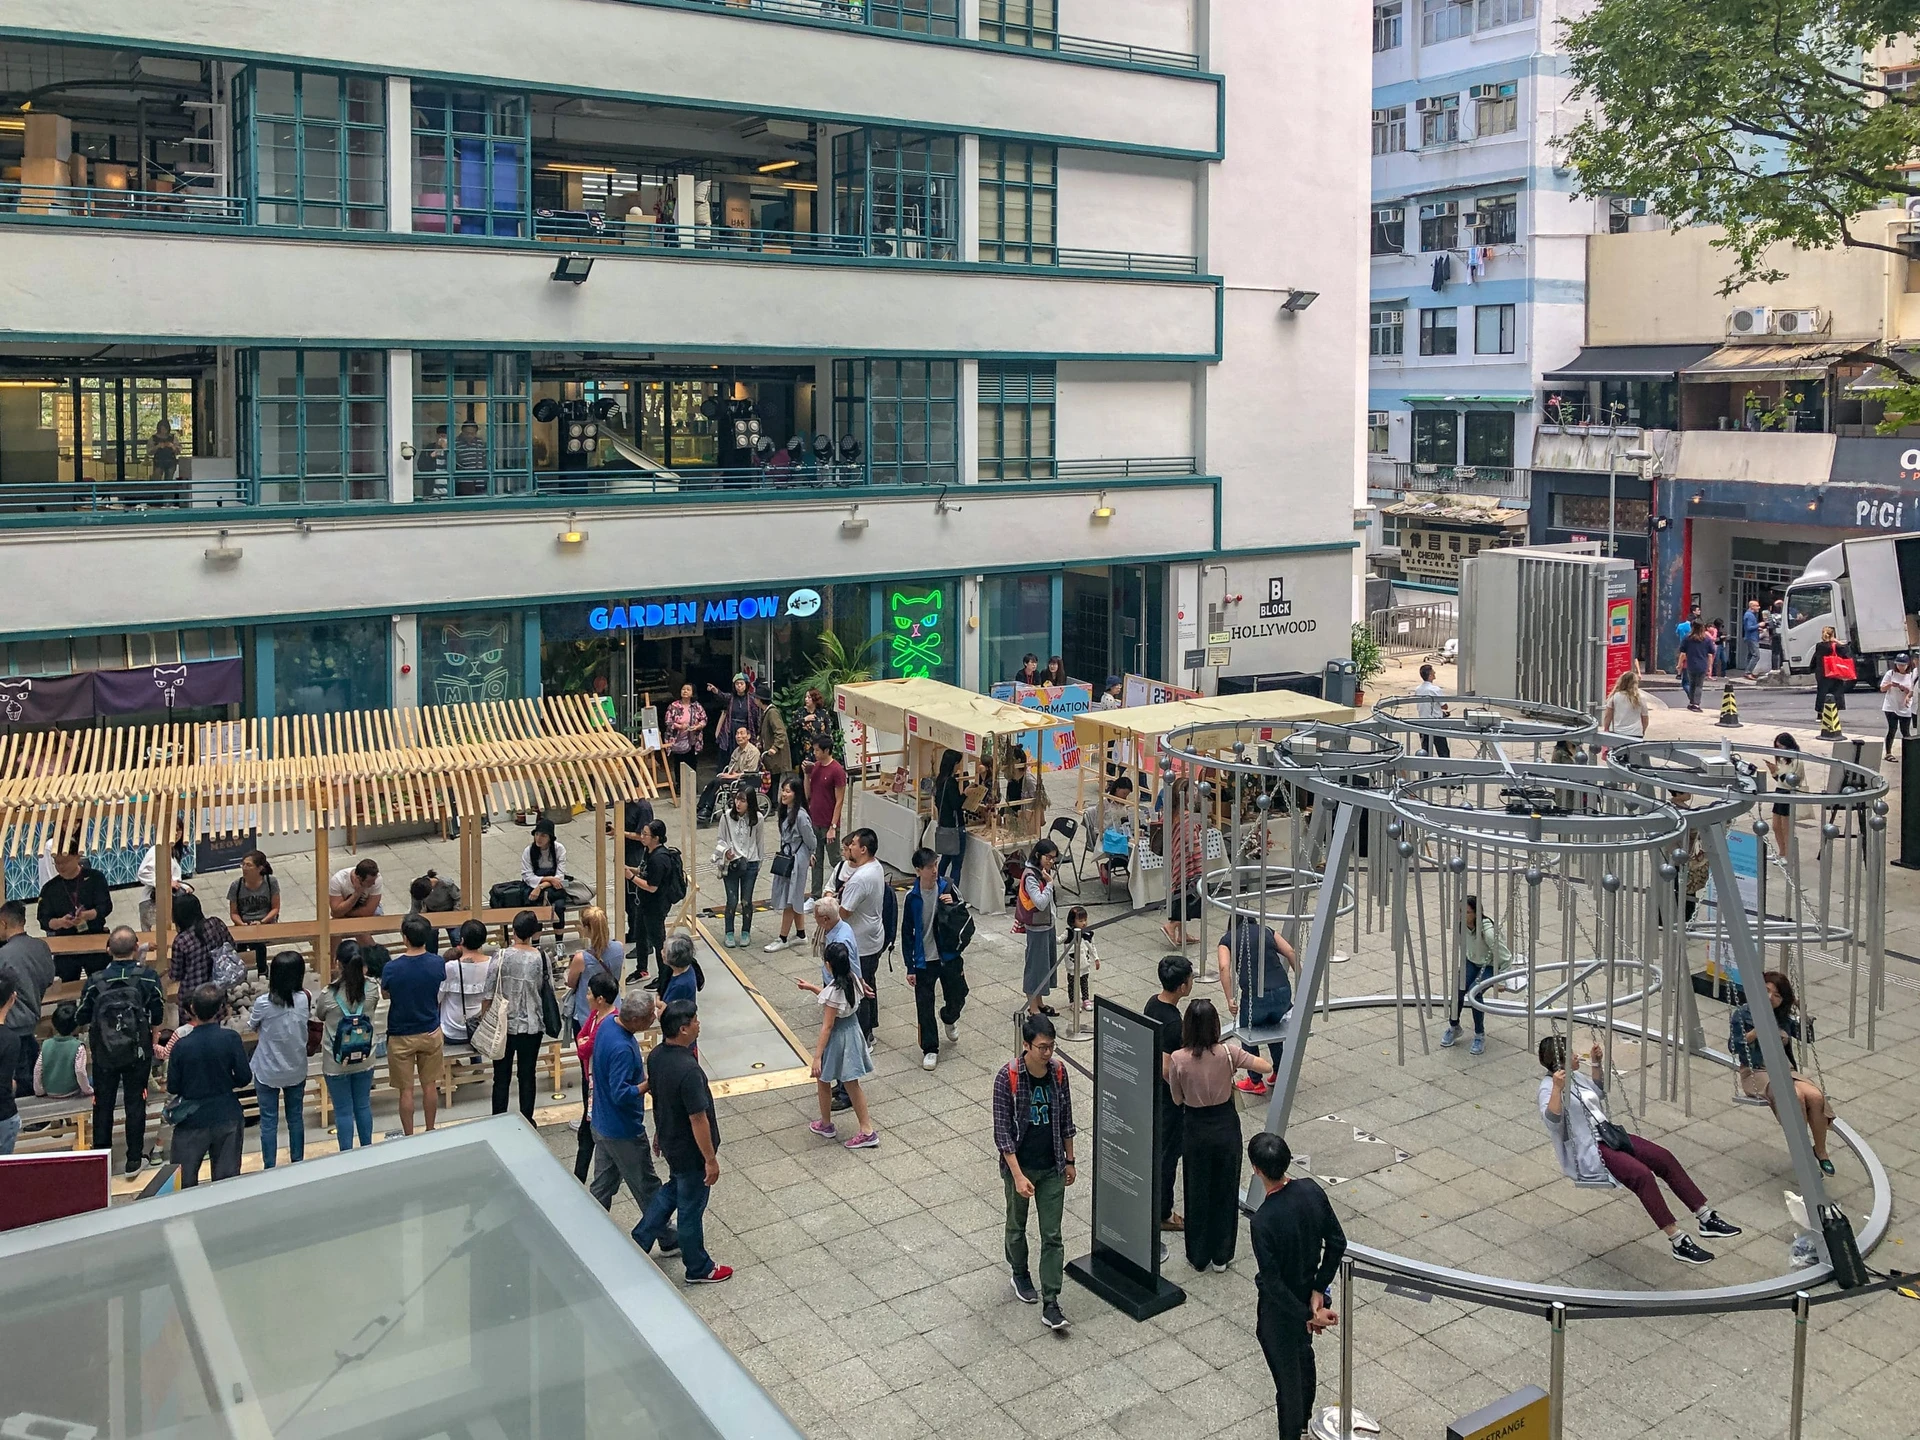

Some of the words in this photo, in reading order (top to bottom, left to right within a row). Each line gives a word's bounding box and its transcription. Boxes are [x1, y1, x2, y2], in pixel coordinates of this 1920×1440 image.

[1418, 551, 1445, 561] CHEONG
[1271, 580, 1282, 600] B
[589, 602, 698, 631] GARDEN
[703, 596, 780, 623] MEOW
[1261, 603, 1290, 617] BLOCK
[1231, 619, 1317, 640] HOLLYWOOD
